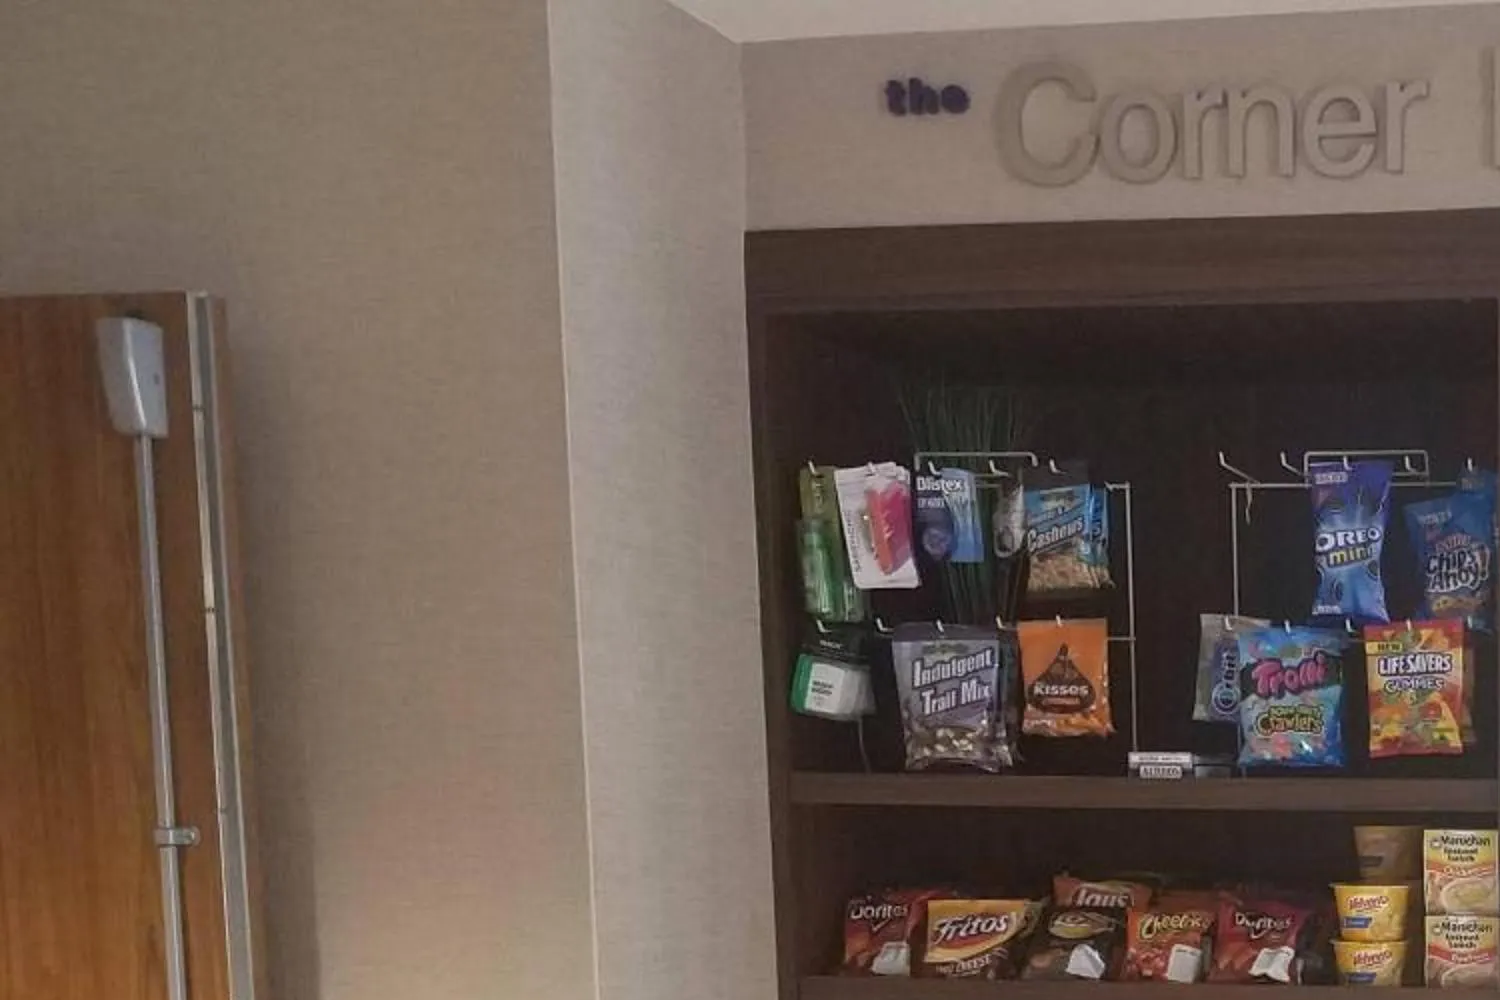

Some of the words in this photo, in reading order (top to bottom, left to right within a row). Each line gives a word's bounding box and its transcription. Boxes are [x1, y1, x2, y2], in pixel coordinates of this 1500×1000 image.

[884, 78, 971, 117] the
[1001, 58, 1431, 190] Corner
[1027, 516, 1084, 553] Cashews
[1315, 527, 1382, 552] OREO
[912, 649, 995, 688] Indulgent
[1252, 651, 1329, 698] Trolli
[921, 687, 958, 718] Trail
[960, 680, 992, 703] Mix
[932, 914, 1009, 945] Fritos
